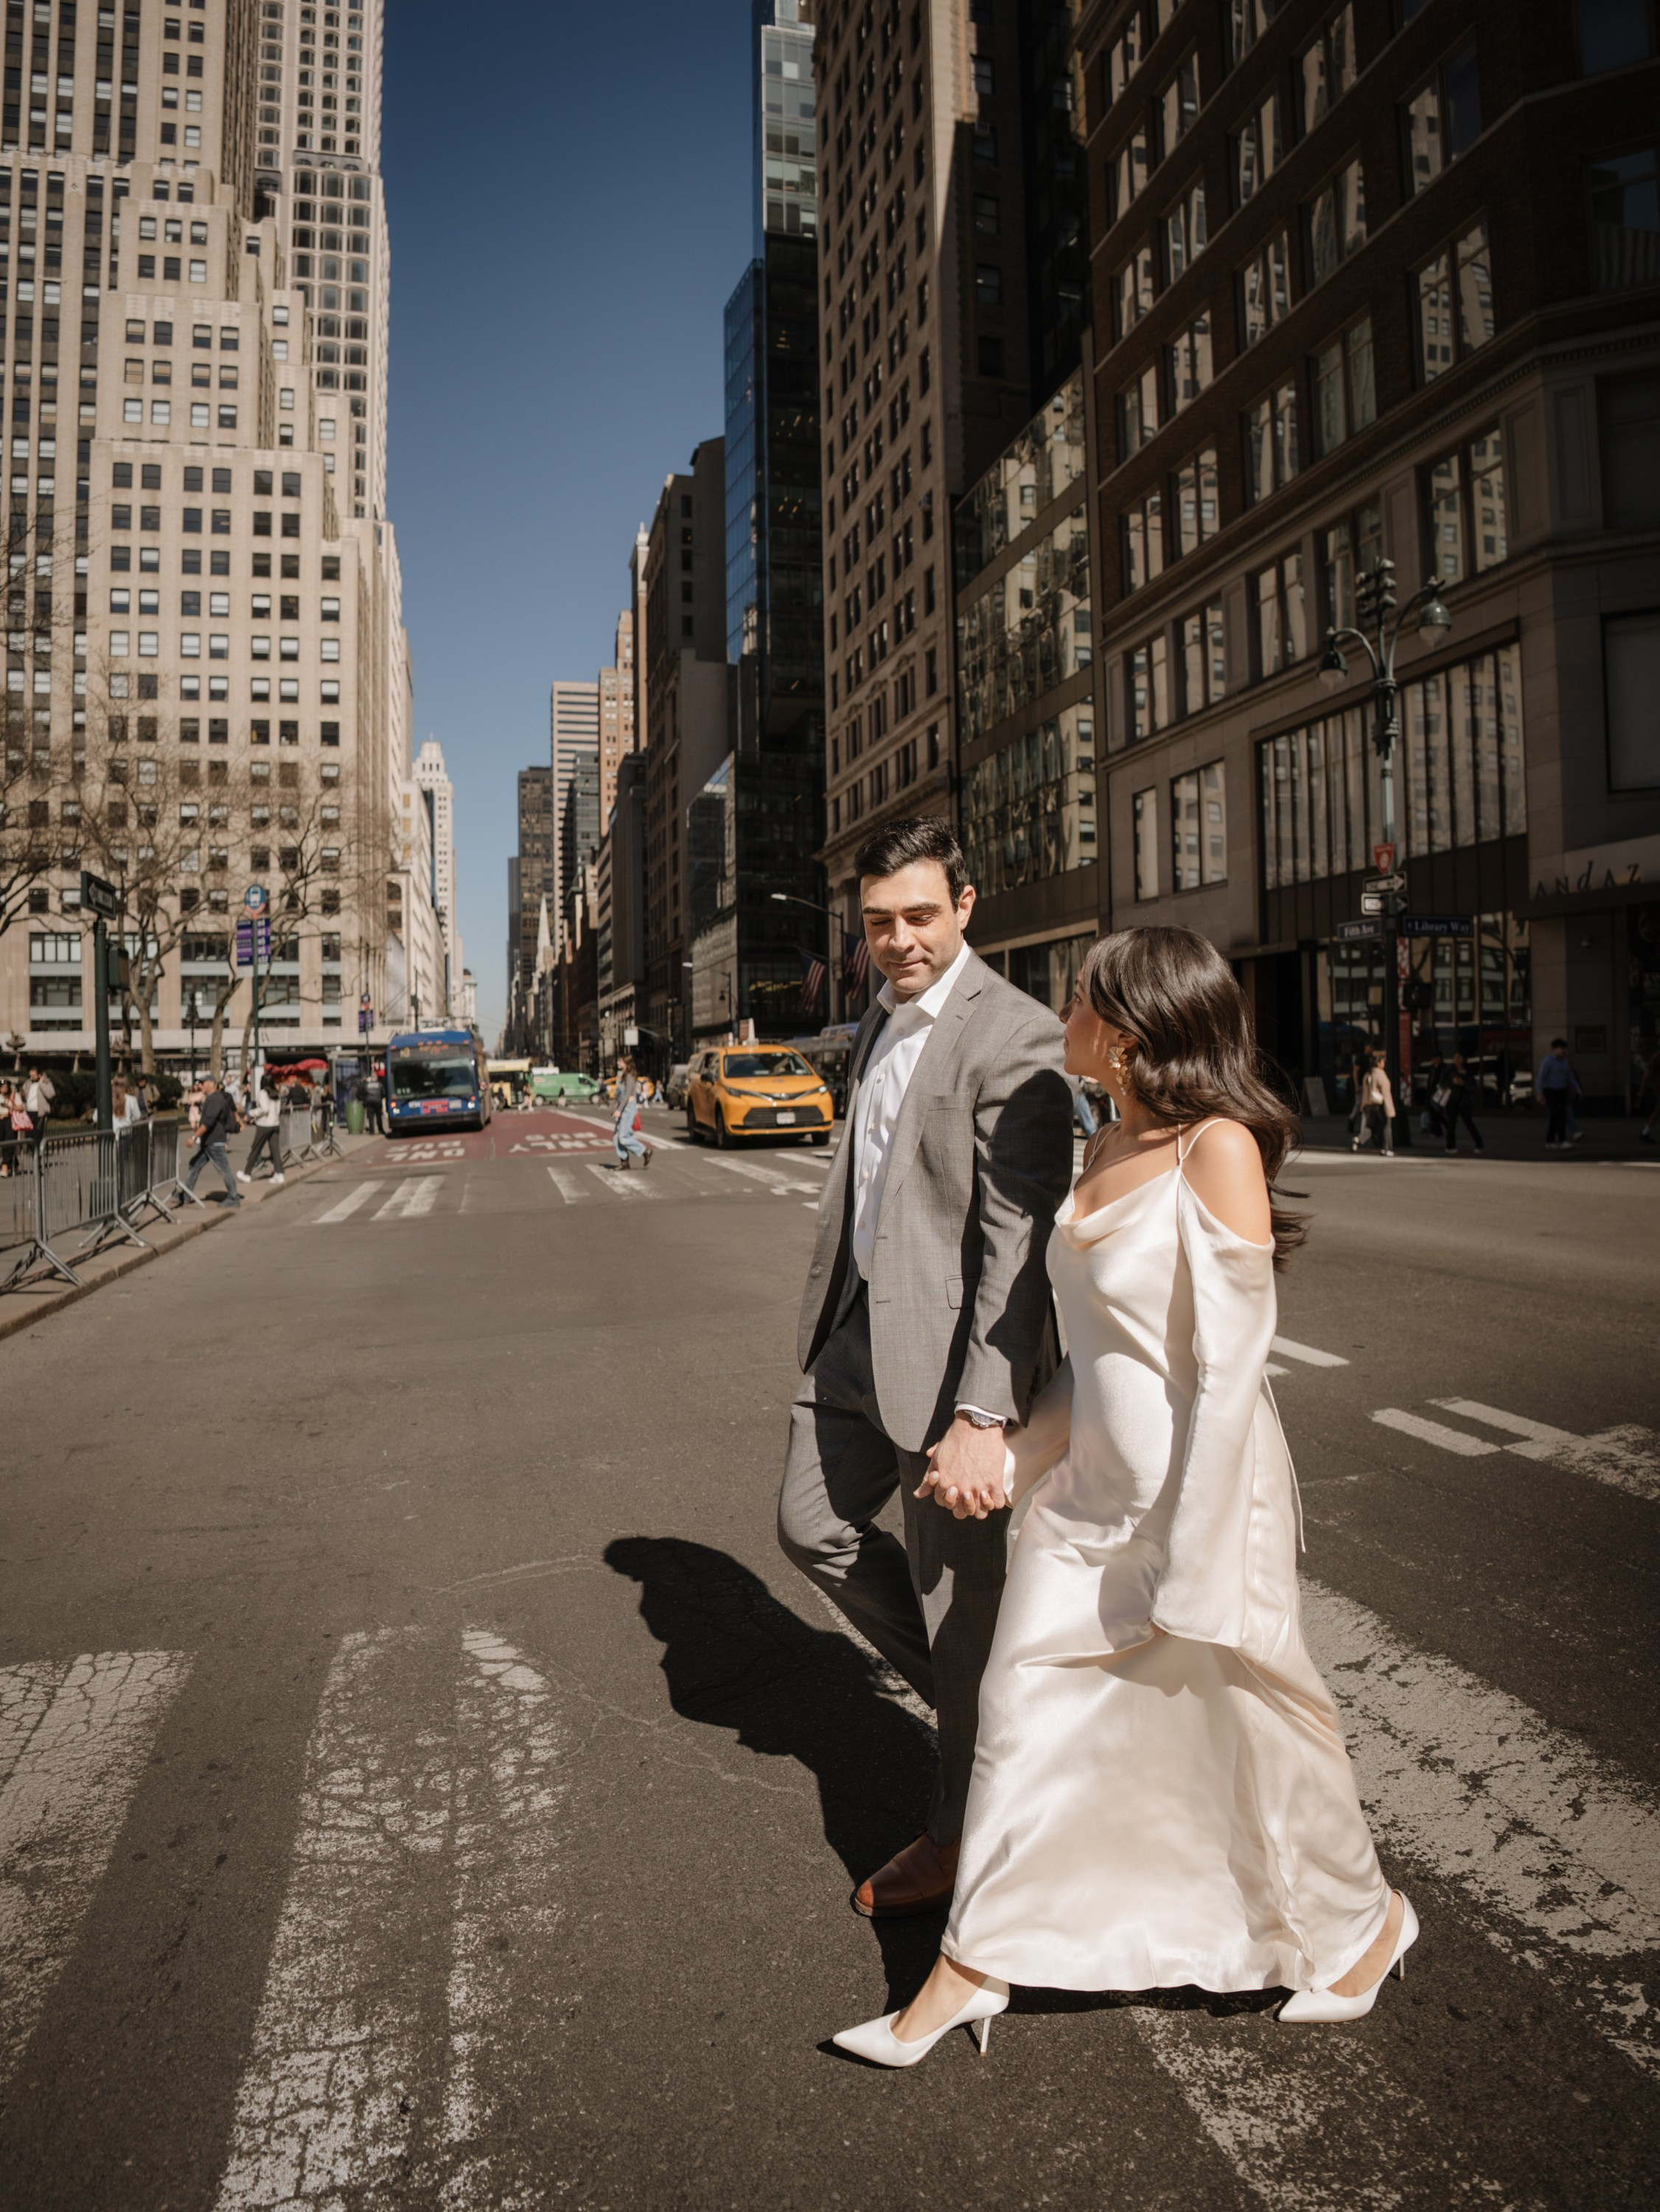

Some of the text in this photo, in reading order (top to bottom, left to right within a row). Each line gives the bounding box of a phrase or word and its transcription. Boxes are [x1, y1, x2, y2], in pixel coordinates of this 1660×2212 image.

[1345, 924, 1374, 937] Fifth Ave
[1415, 920, 1448, 934] Library
[1450, 921, 1470, 934] Way
[525, 1132, 597, 1141] BUS
[387, 1140, 461, 1152] BUS
[509, 1139, 615, 1152] ONLY
